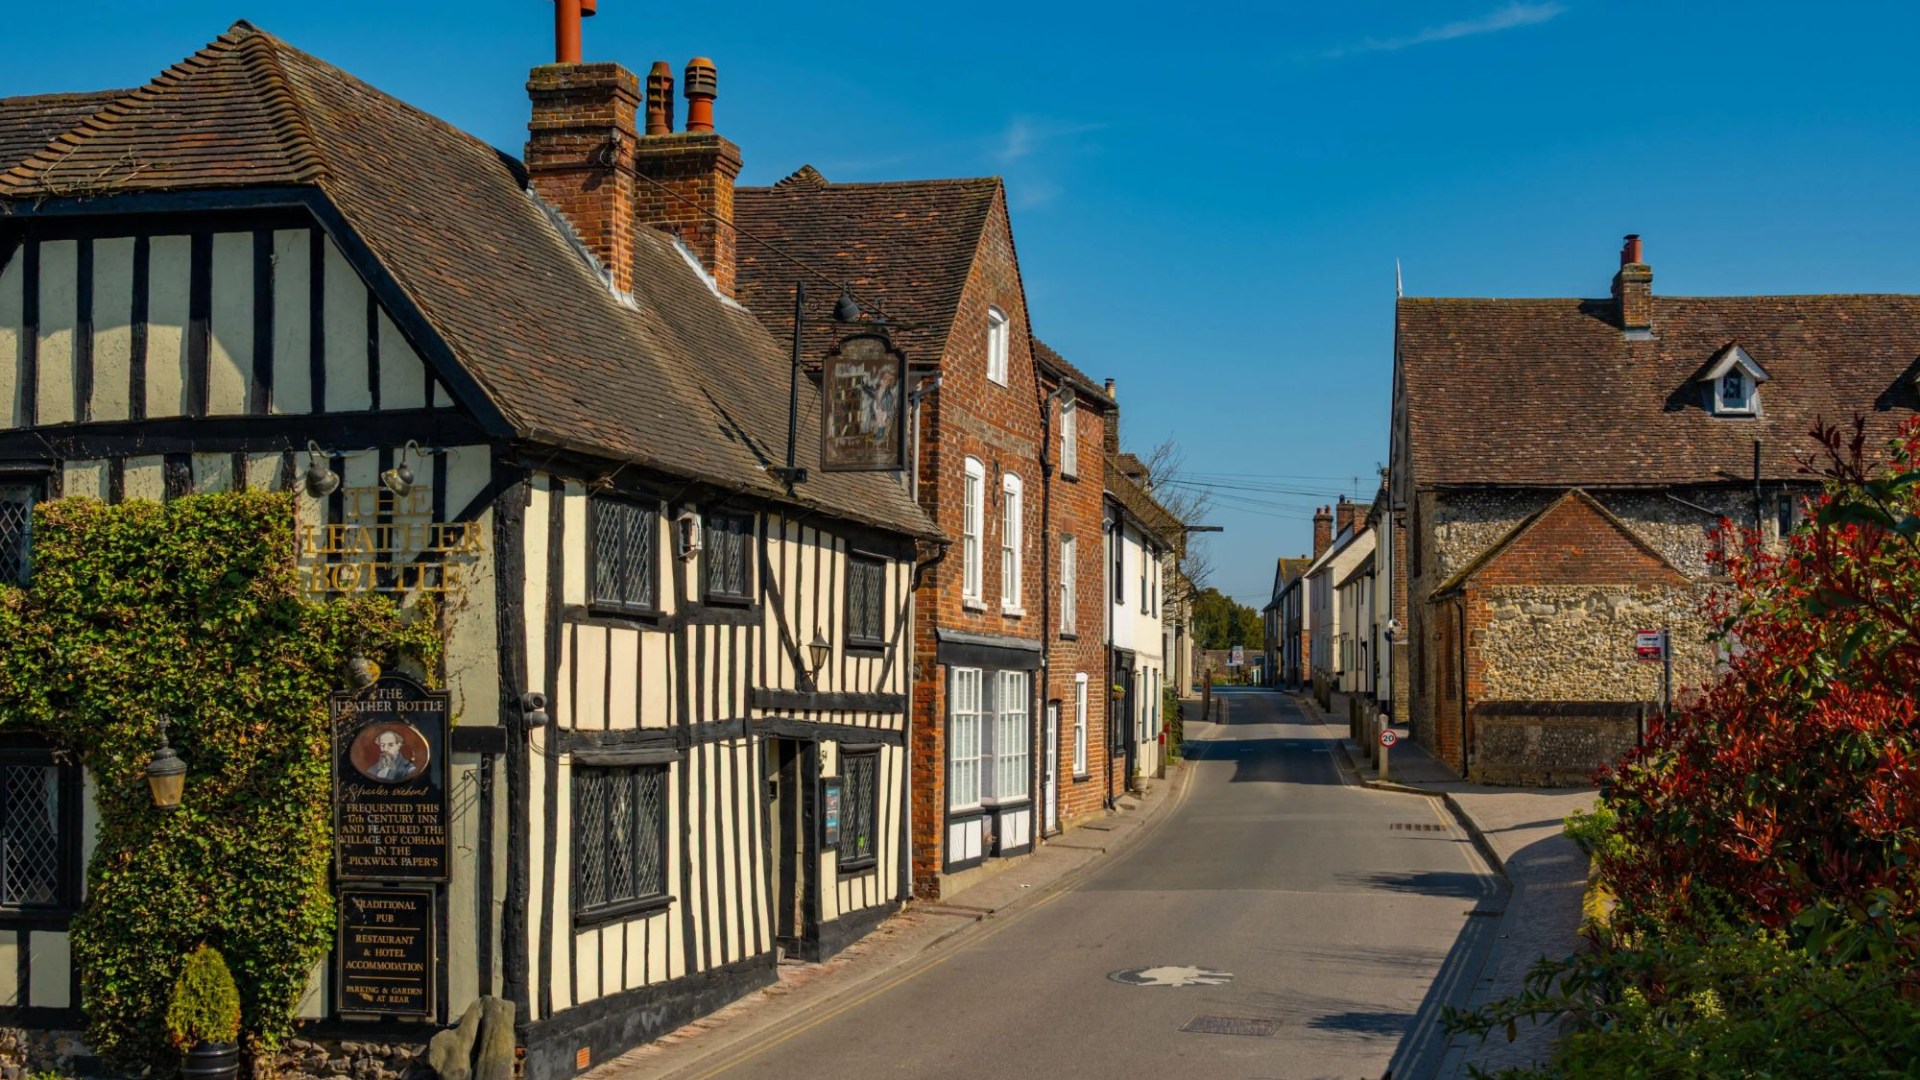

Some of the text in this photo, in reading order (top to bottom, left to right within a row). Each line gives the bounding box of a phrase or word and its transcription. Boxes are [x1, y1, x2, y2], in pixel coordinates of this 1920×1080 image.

[344, 486, 433, 517] THE
[303, 522, 485, 554] LEATHER
[308, 562, 462, 593] BOTTLE
[379, 688, 403, 699] THE
[337, 701, 444, 712] LEATHER BOTTLE
[346, 804, 439, 813] FREQUENTED THIS
[368, 815, 414, 823] CENTURY
[418, 815, 437, 824] INN
[342, 825, 444, 834] AND FEATURED THE
[340, 836, 444, 845] VILLAGE OF COBHAM
[375, 847, 411, 855] IN THE
[349, 857, 398, 865] PICKWICK
[355, 899, 416, 910] TRADITIONAL
[376, 914, 394, 922] PUB
[355, 935, 414, 944] RESTAURANT
[363, 948, 405, 957] & HOTEL
[346, 961, 423, 971] ACCOMMODATION
[346, 985, 379, 994] PARKING
[392, 987, 422, 995] GARDEN
